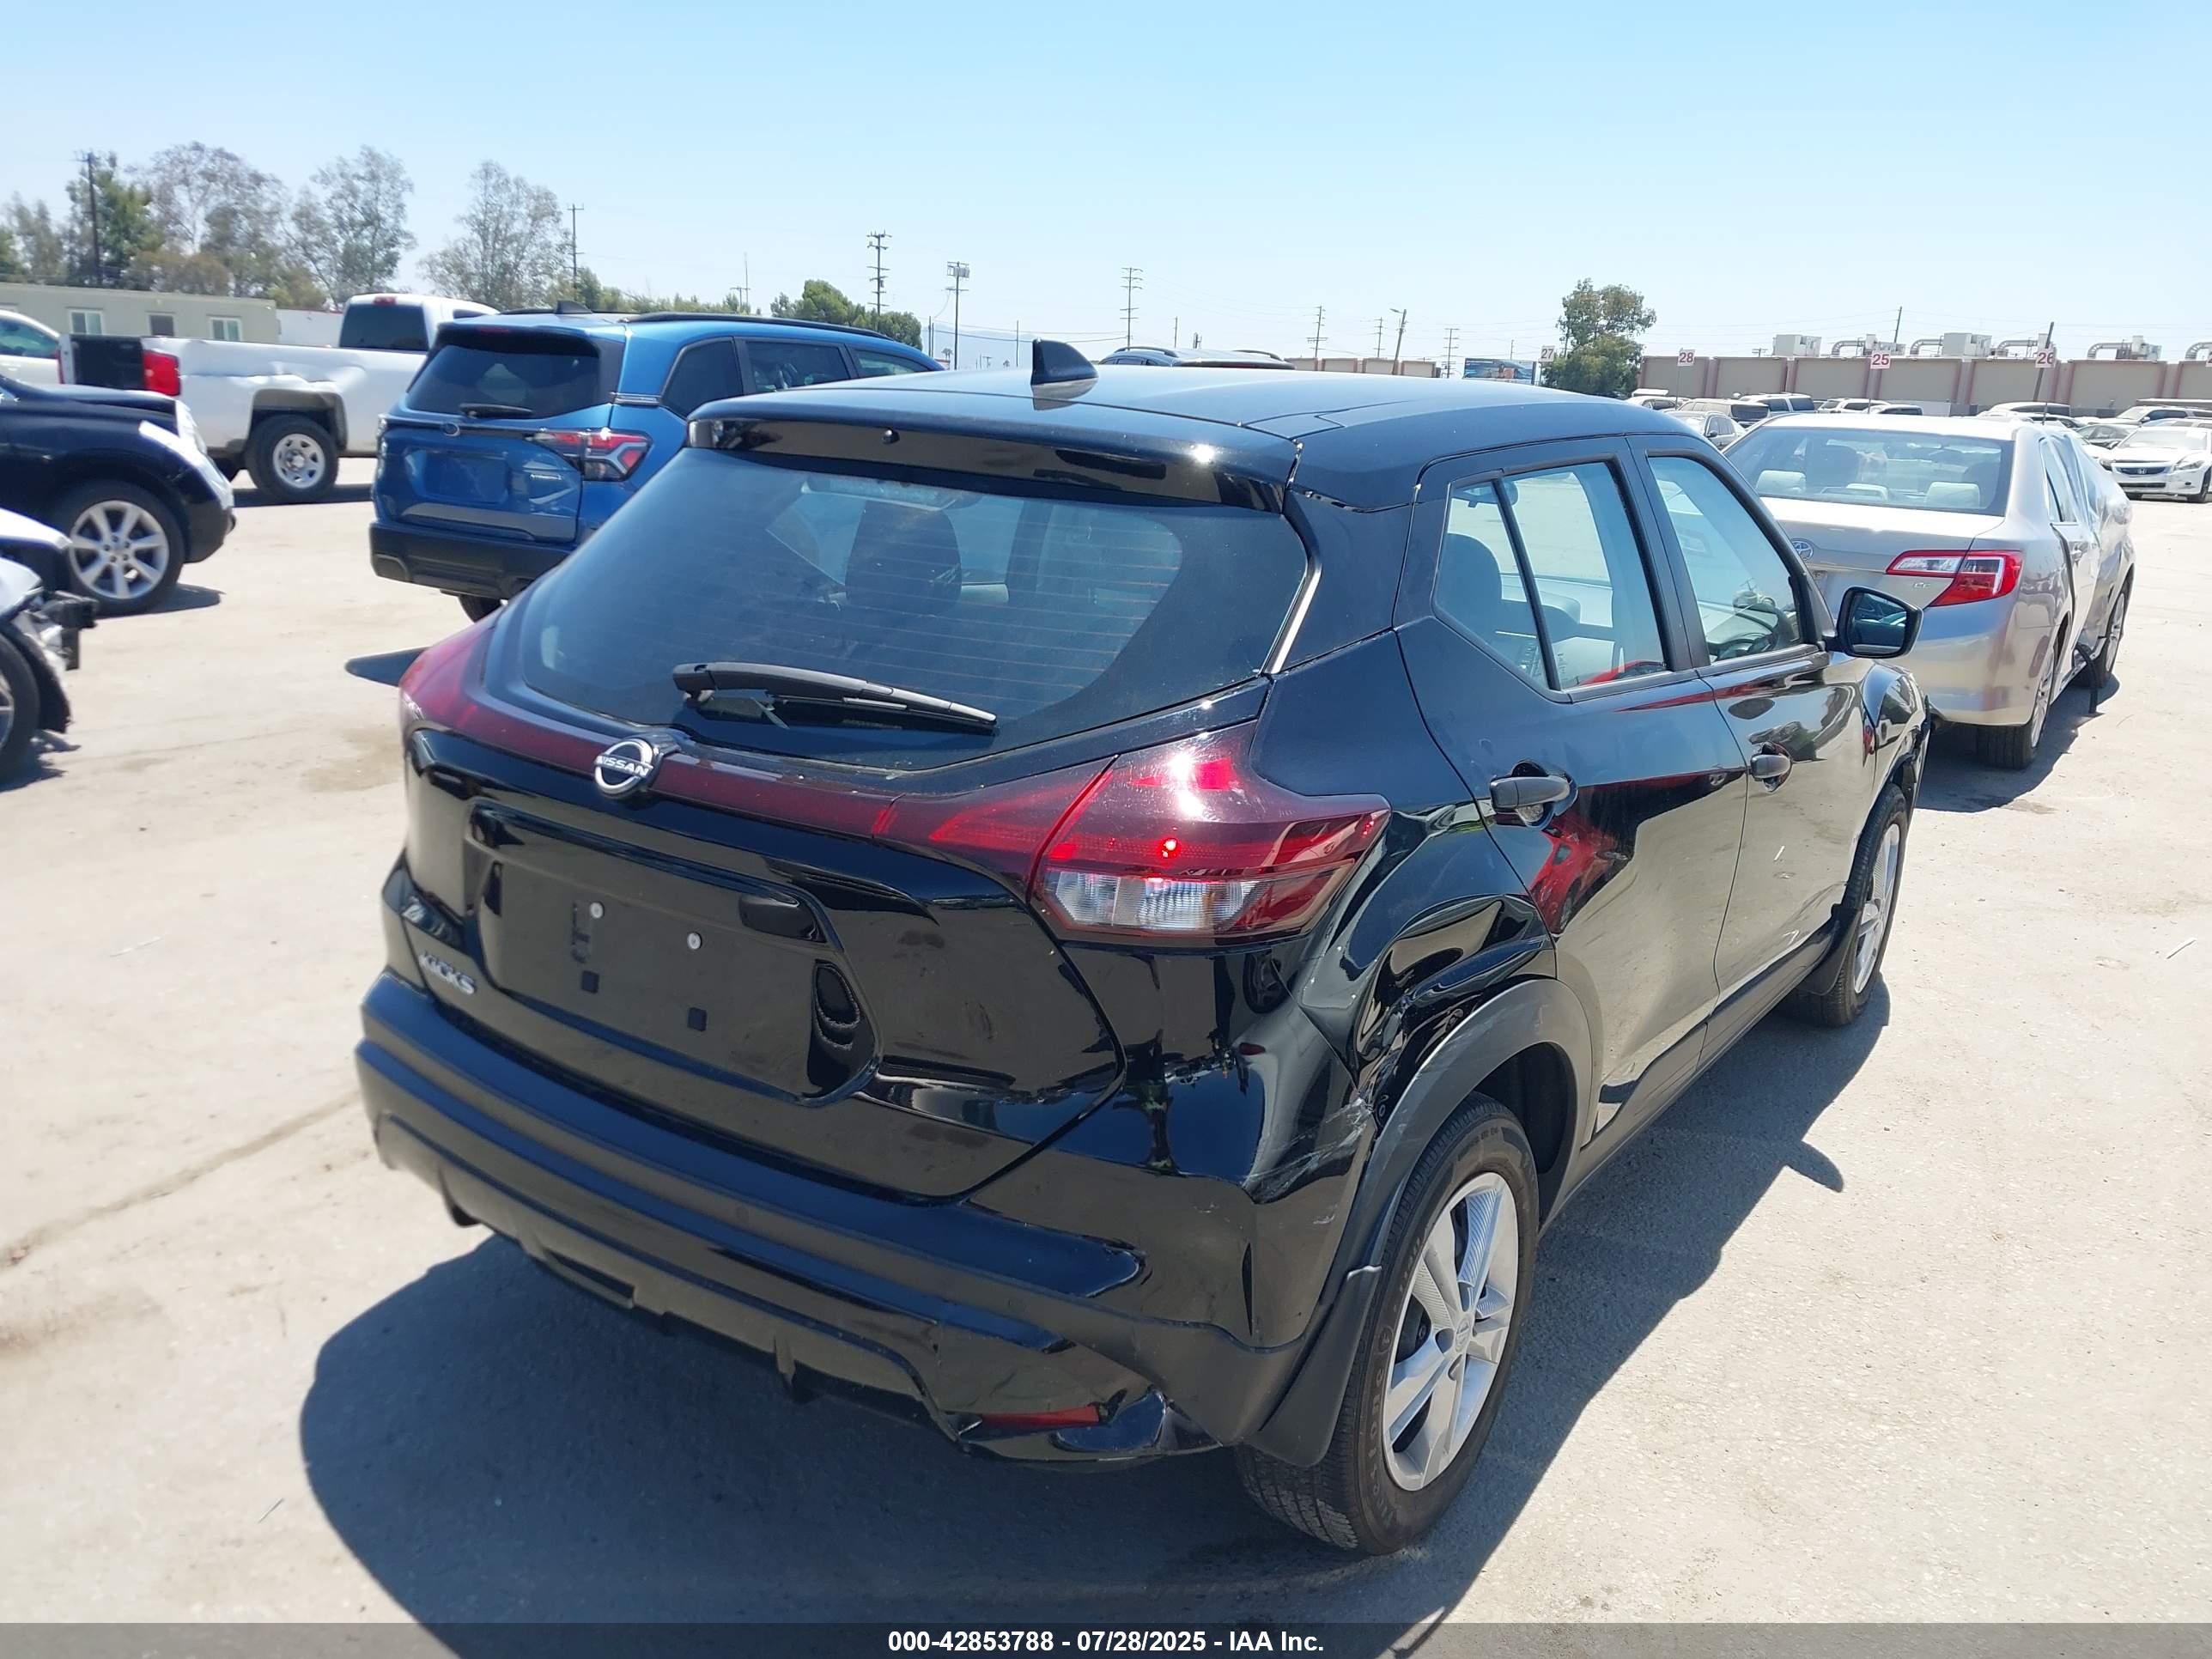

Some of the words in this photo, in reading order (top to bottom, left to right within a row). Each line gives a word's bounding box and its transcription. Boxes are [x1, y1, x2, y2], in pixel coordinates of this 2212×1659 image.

[1540, 348, 1554, 359] 27
[1679, 352, 1694, 363] 28
[1871, 353, 1889, 366] 25
[2037, 352, 2055, 365] 26
[596, 755, 649, 776] NISSAN
[418, 951, 475, 995] KICKS
